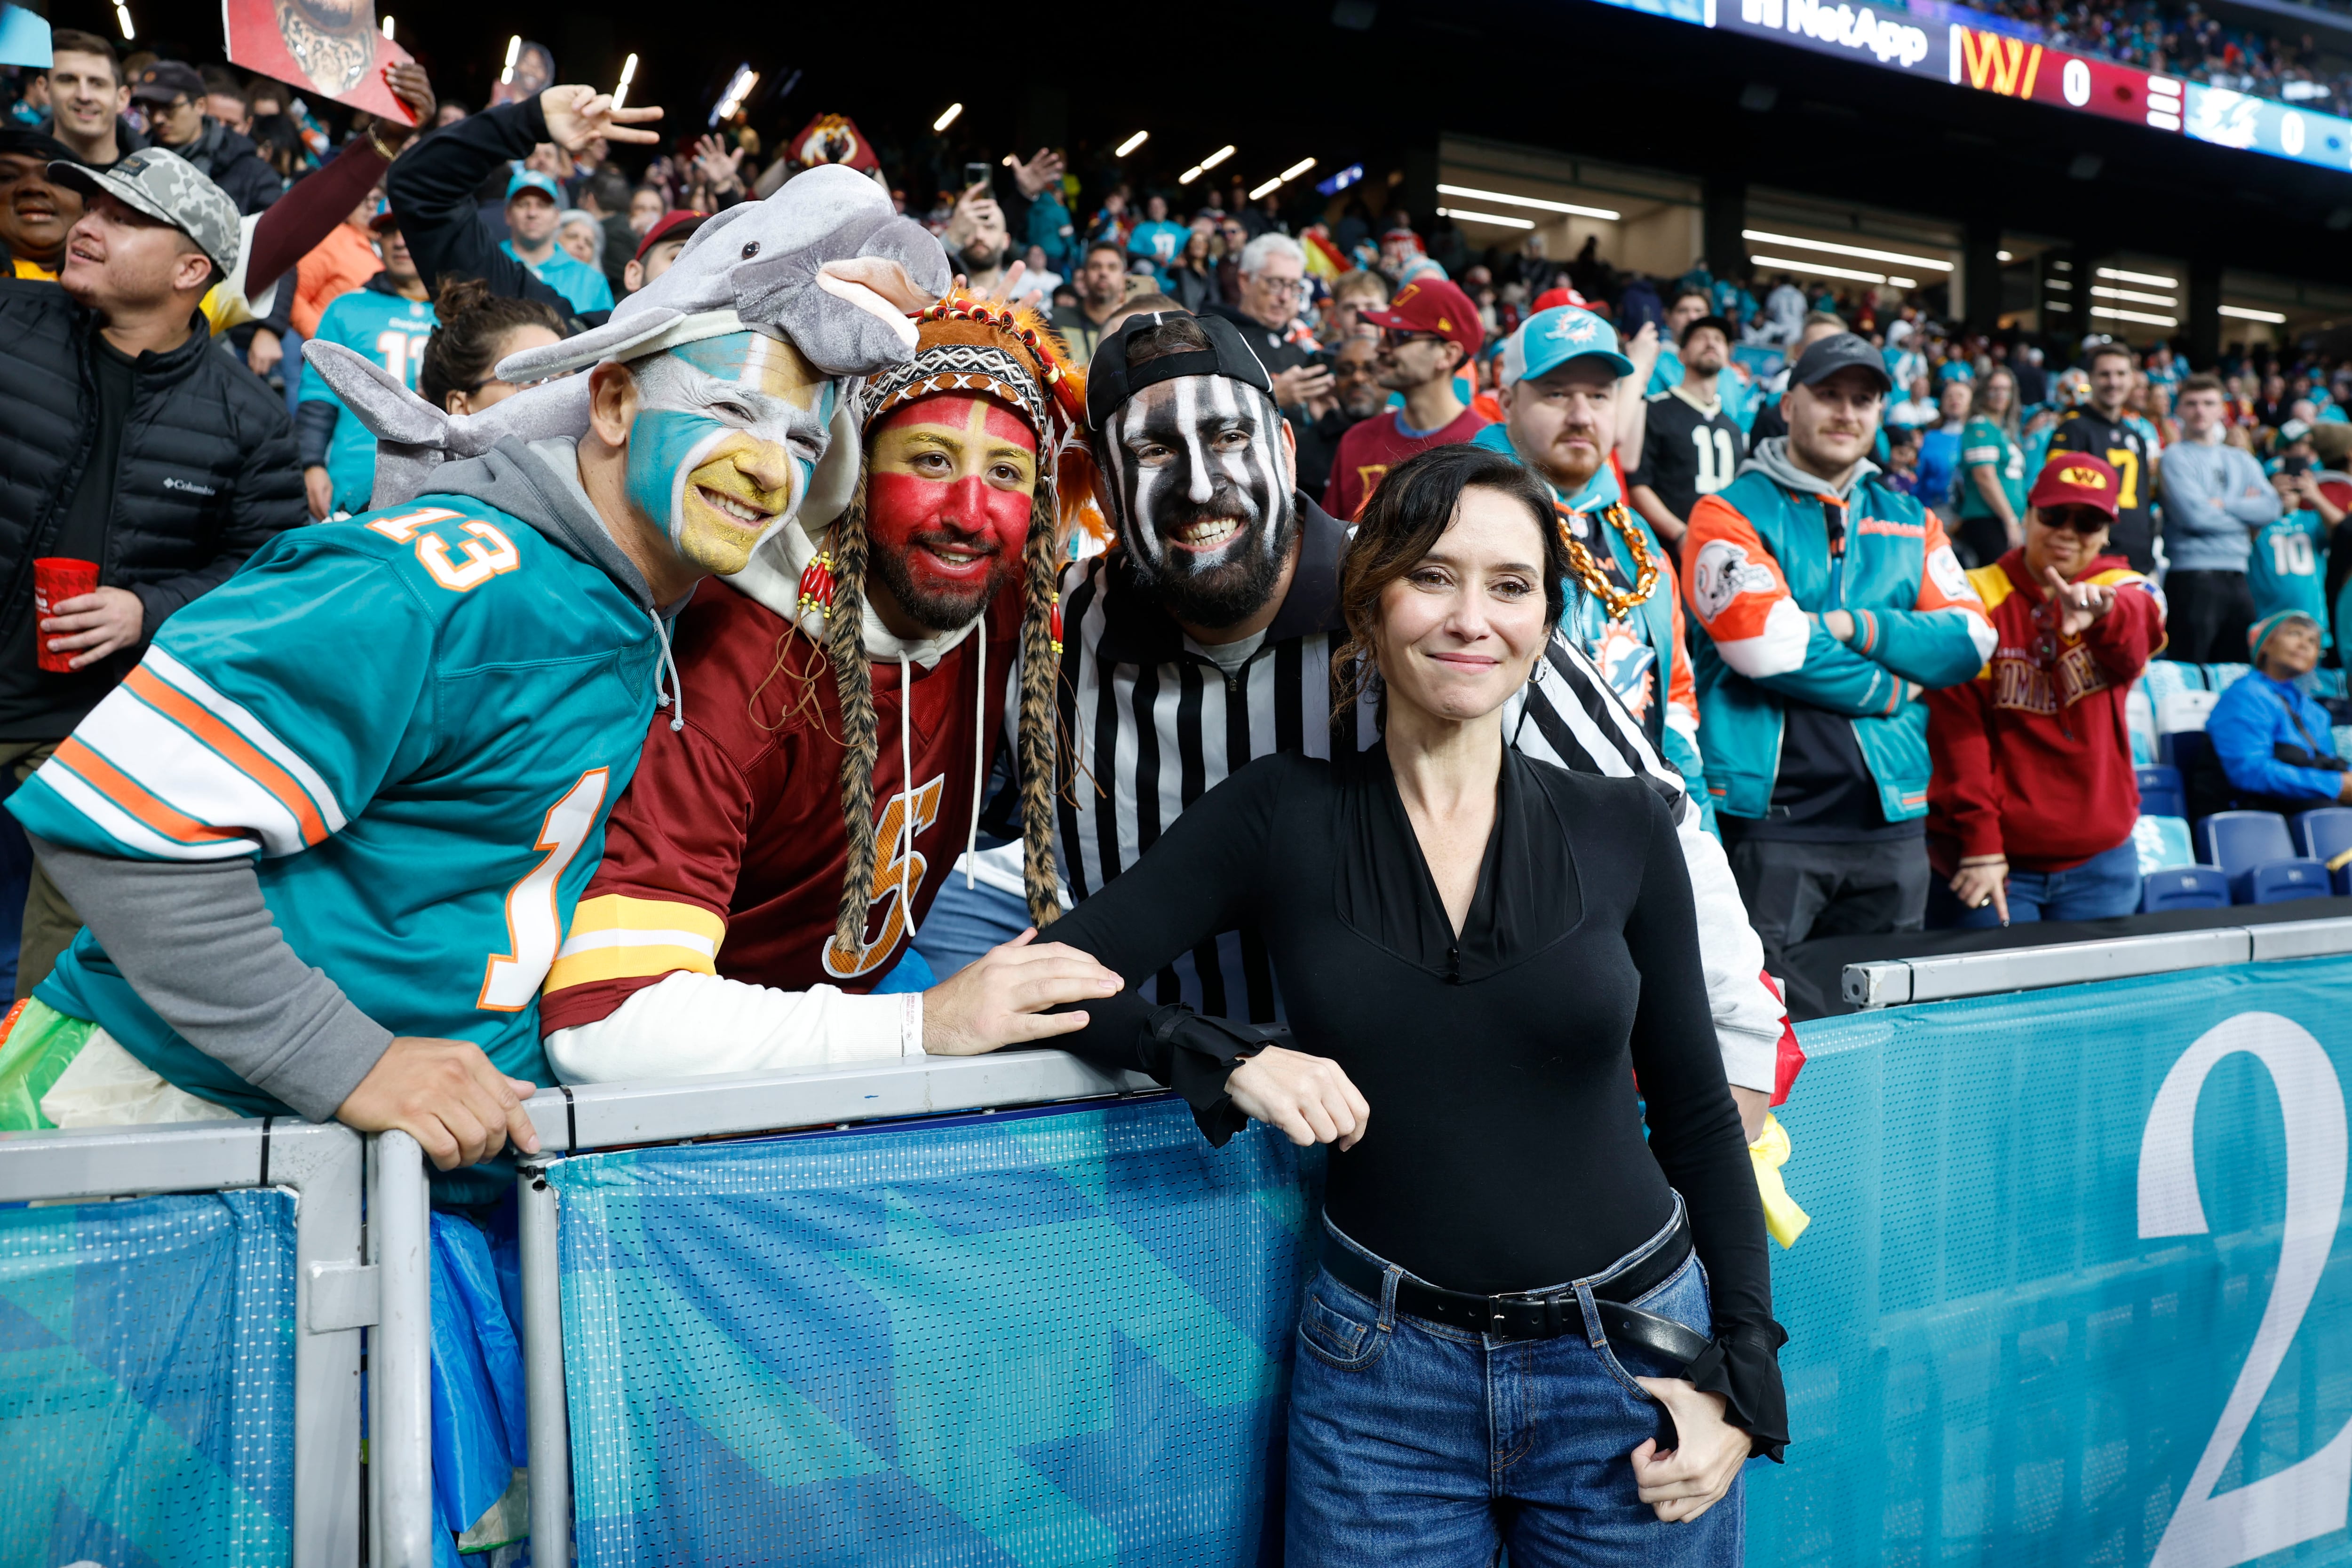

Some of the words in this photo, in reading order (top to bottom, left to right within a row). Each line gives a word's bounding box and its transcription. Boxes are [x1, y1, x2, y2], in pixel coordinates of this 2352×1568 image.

[2063, 59, 2090, 107] 0
[2280, 111, 2304, 156] 0
[174, 479, 215, 496] Columbia
[1691, 424, 1735, 494] 11
[2106, 448, 2139, 509] 7
[366, 507, 520, 592] 13
[2268, 532, 2316, 577] 10
[476, 765, 610, 1013] 1
[821, 772, 945, 979] 5
[2137, 1011, 2352, 1568] 2
